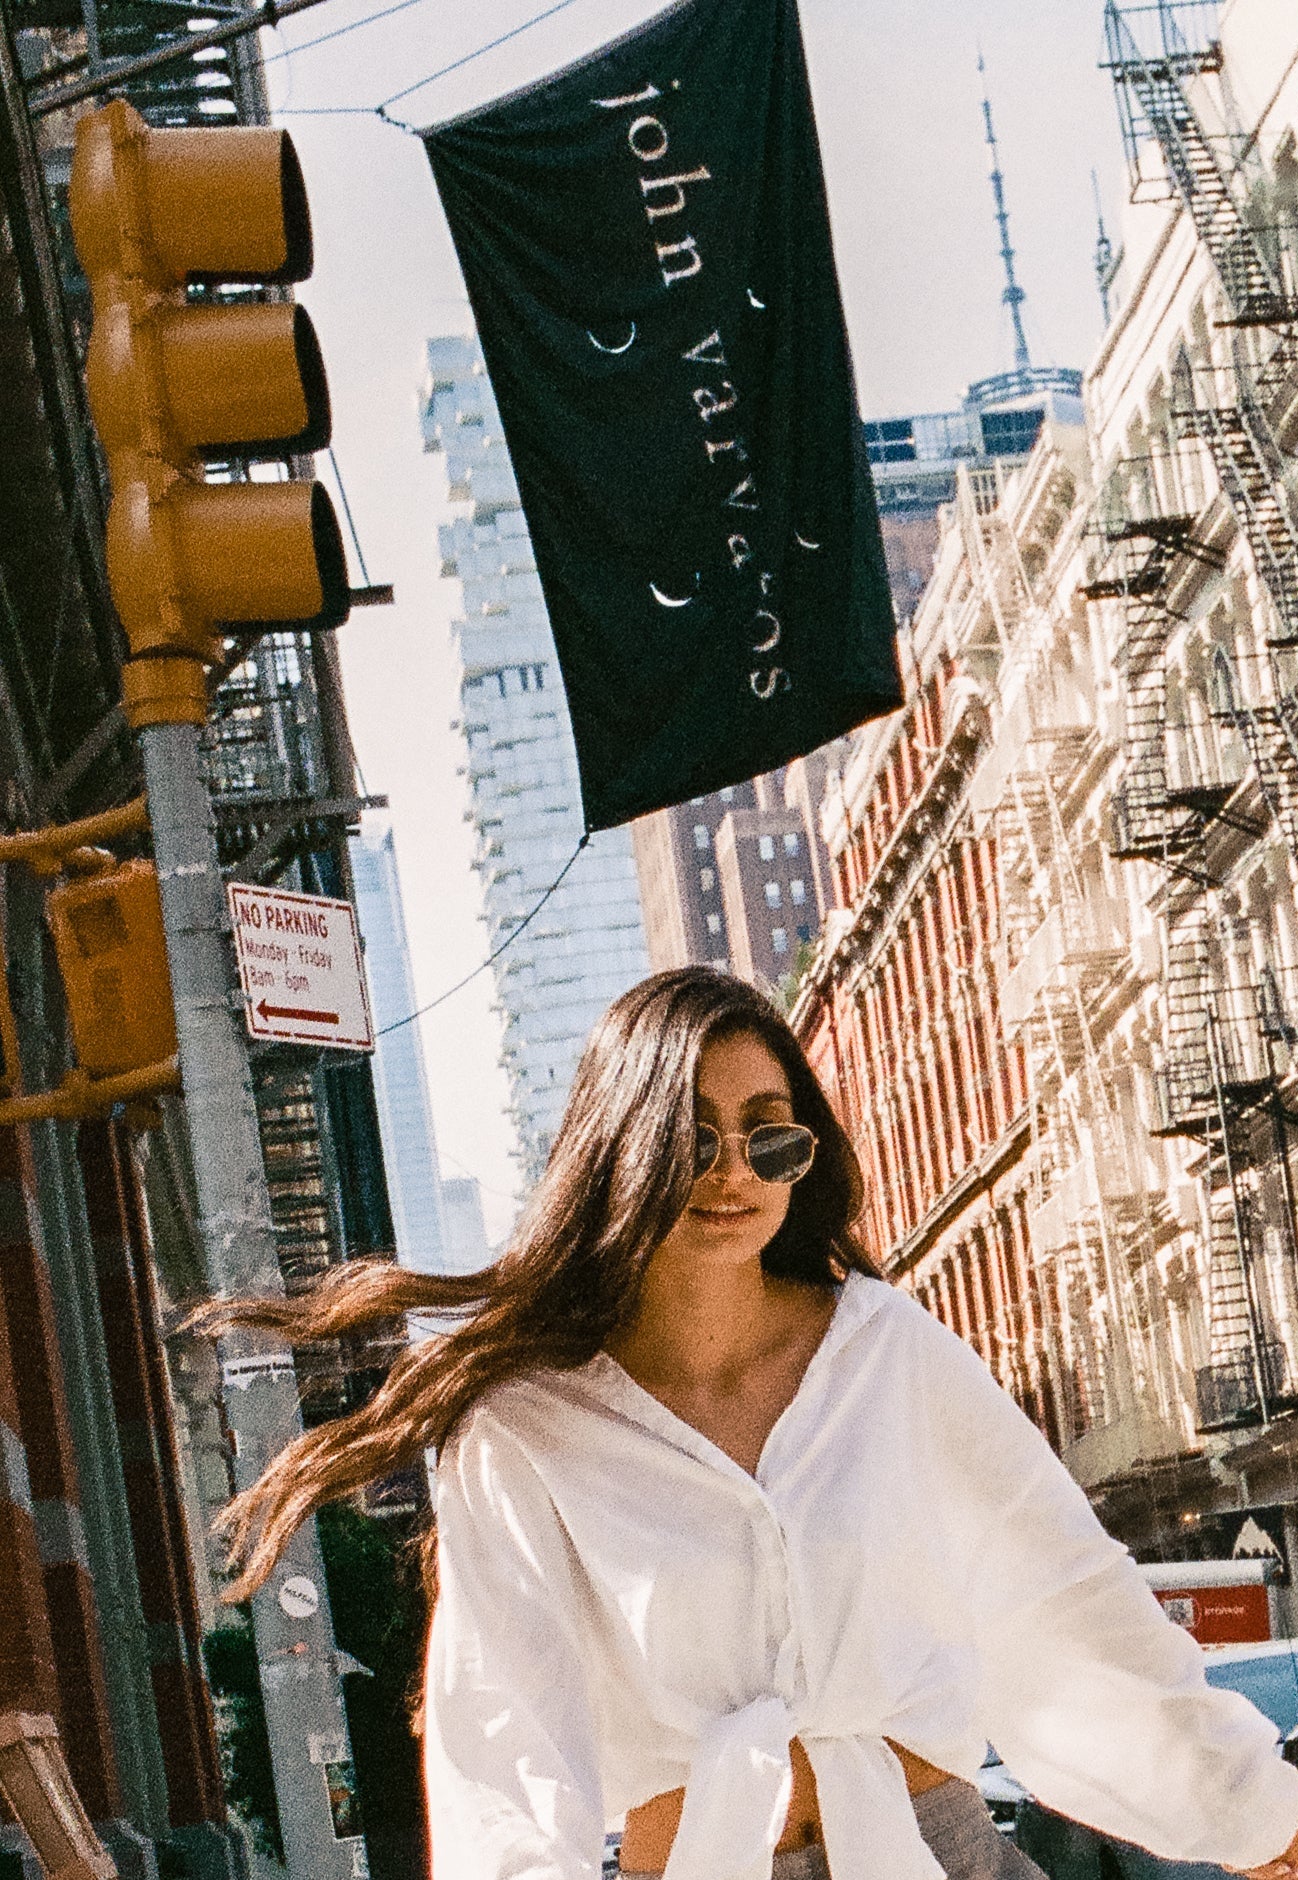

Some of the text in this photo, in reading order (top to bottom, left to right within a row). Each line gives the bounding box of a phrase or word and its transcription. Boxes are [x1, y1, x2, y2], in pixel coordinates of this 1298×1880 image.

[590, 79, 792, 700] john varvaos
[240, 902, 328, 938] NO PARKING
[245, 938, 289, 965] Monday
[298, 944, 332, 968] Friday
[284, 970, 310, 993] 6pm
